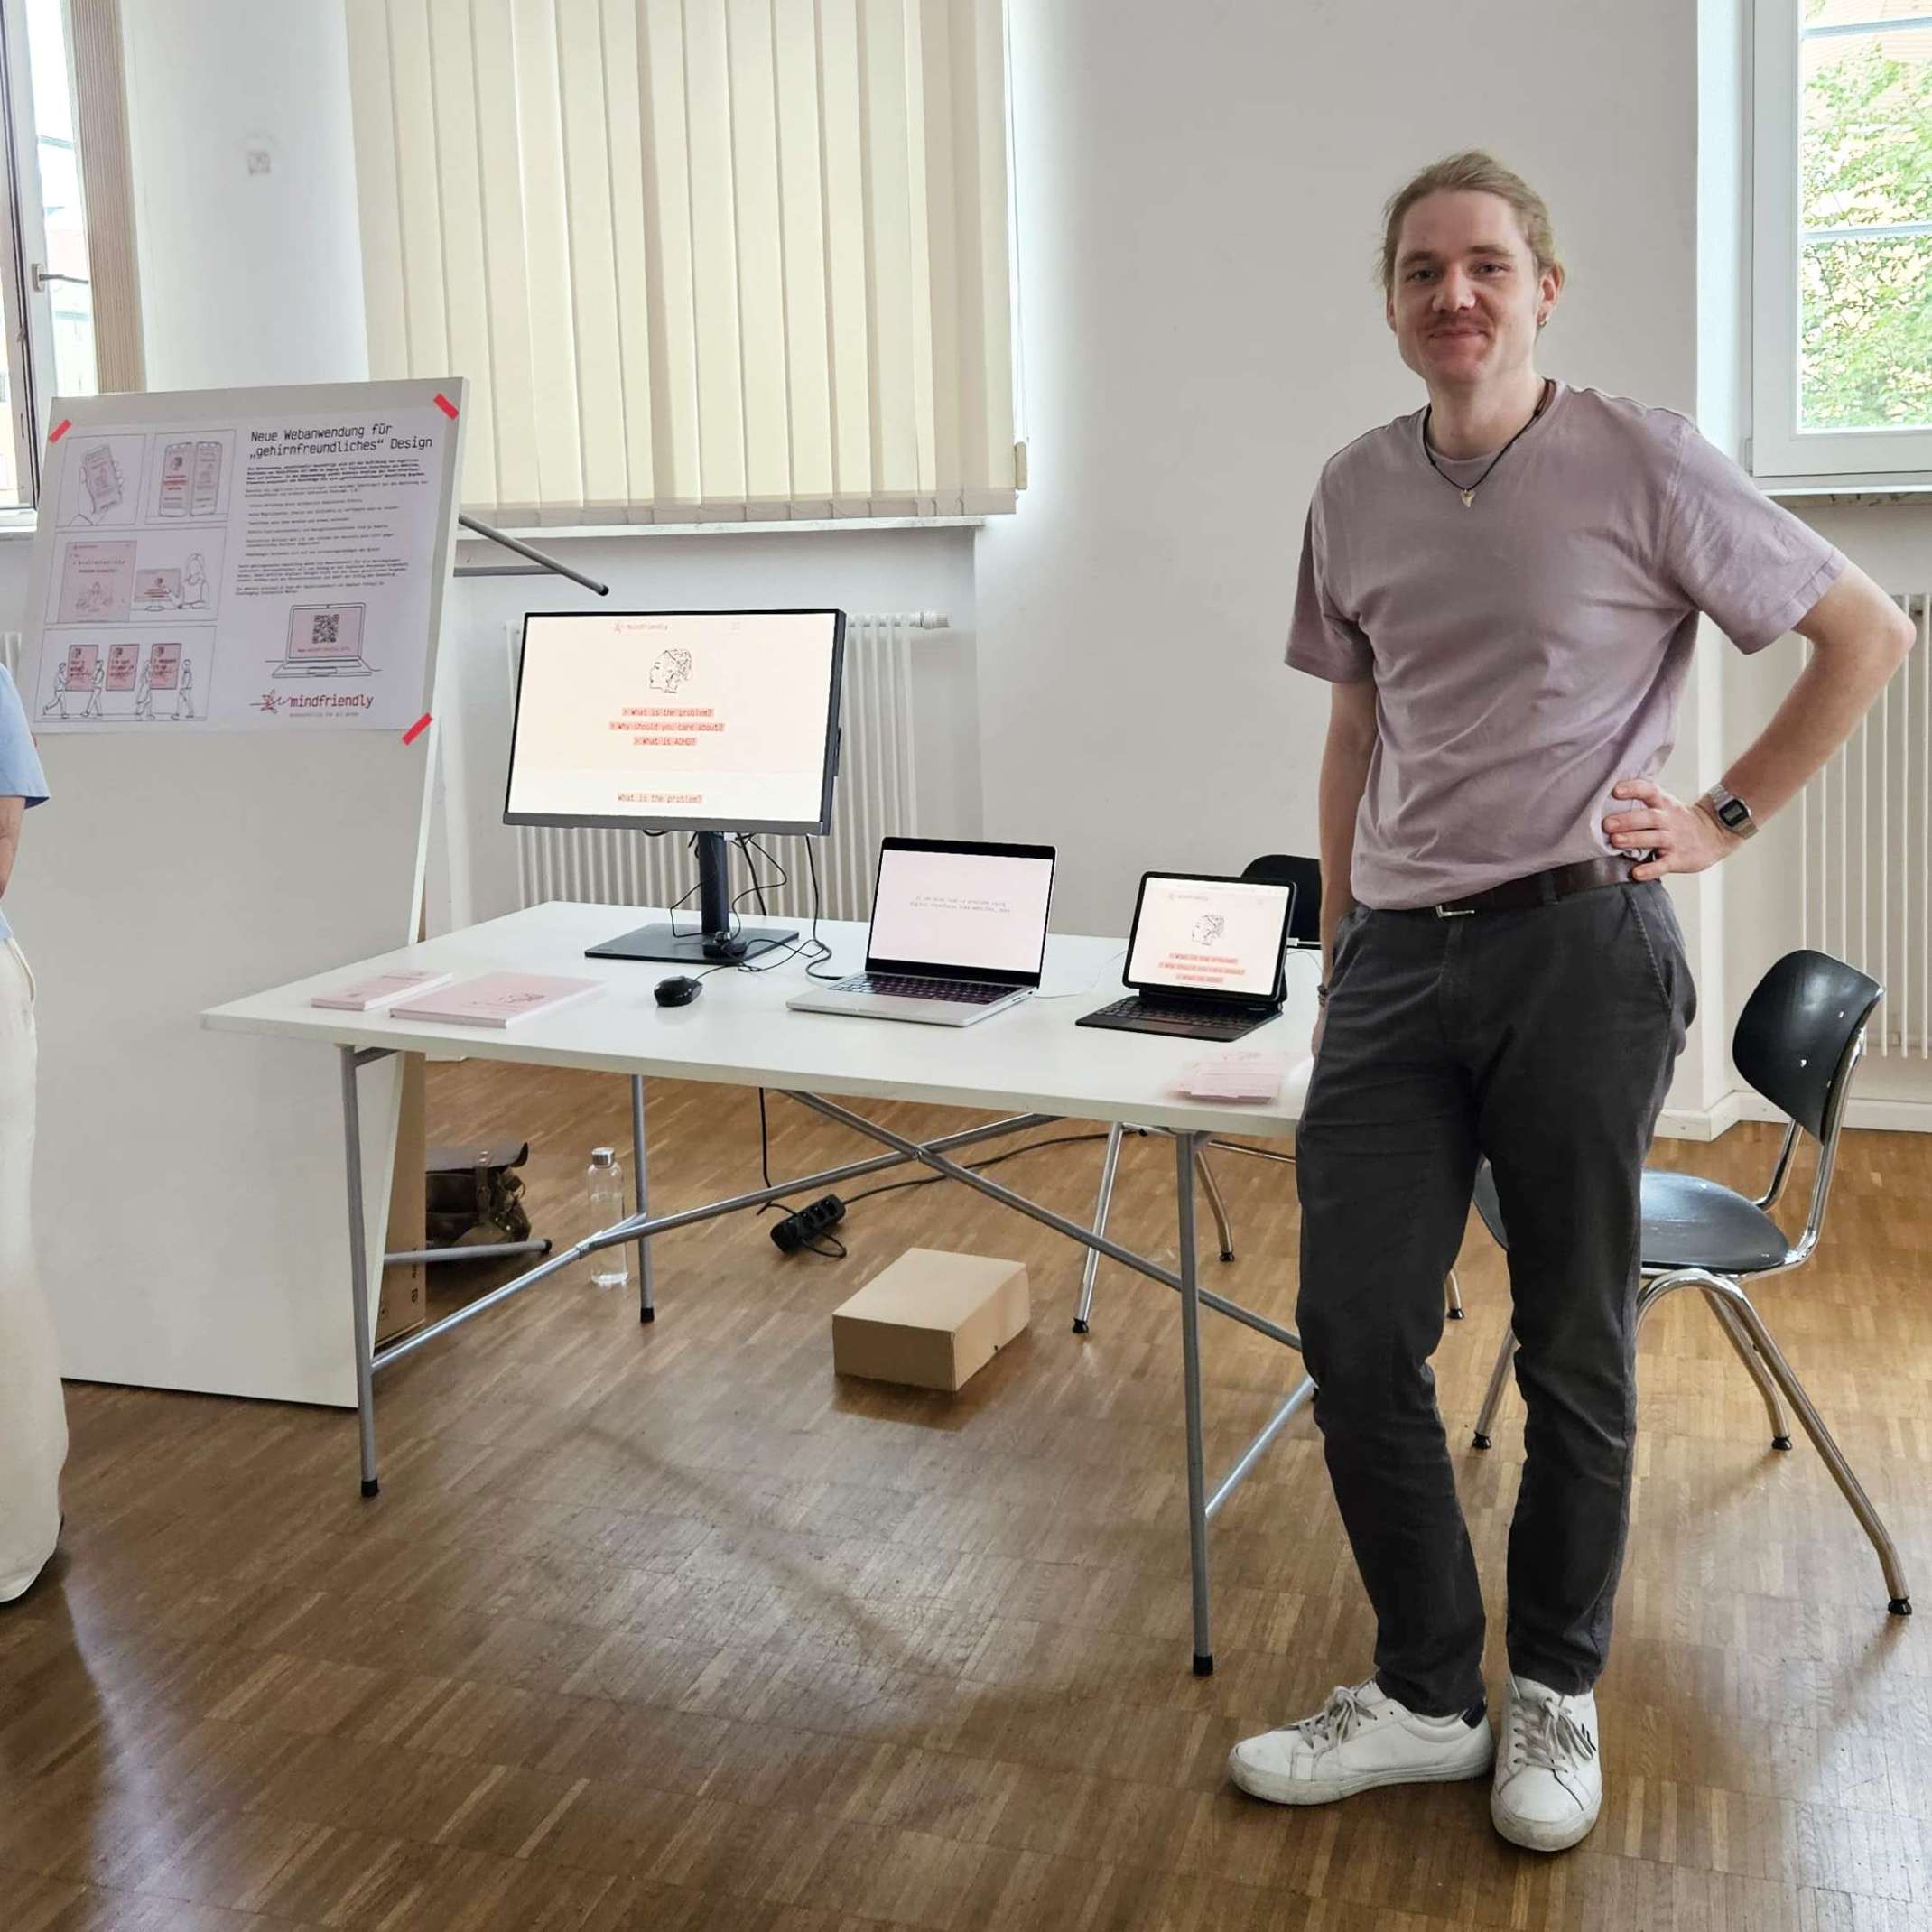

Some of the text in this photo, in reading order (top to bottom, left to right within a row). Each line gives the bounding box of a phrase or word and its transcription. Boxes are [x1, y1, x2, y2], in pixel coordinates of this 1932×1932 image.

[251, 423, 393, 442] Neue Webanwendung für
[390, 436, 433, 450] Design
[289, 693, 375, 710] mindfriendly
